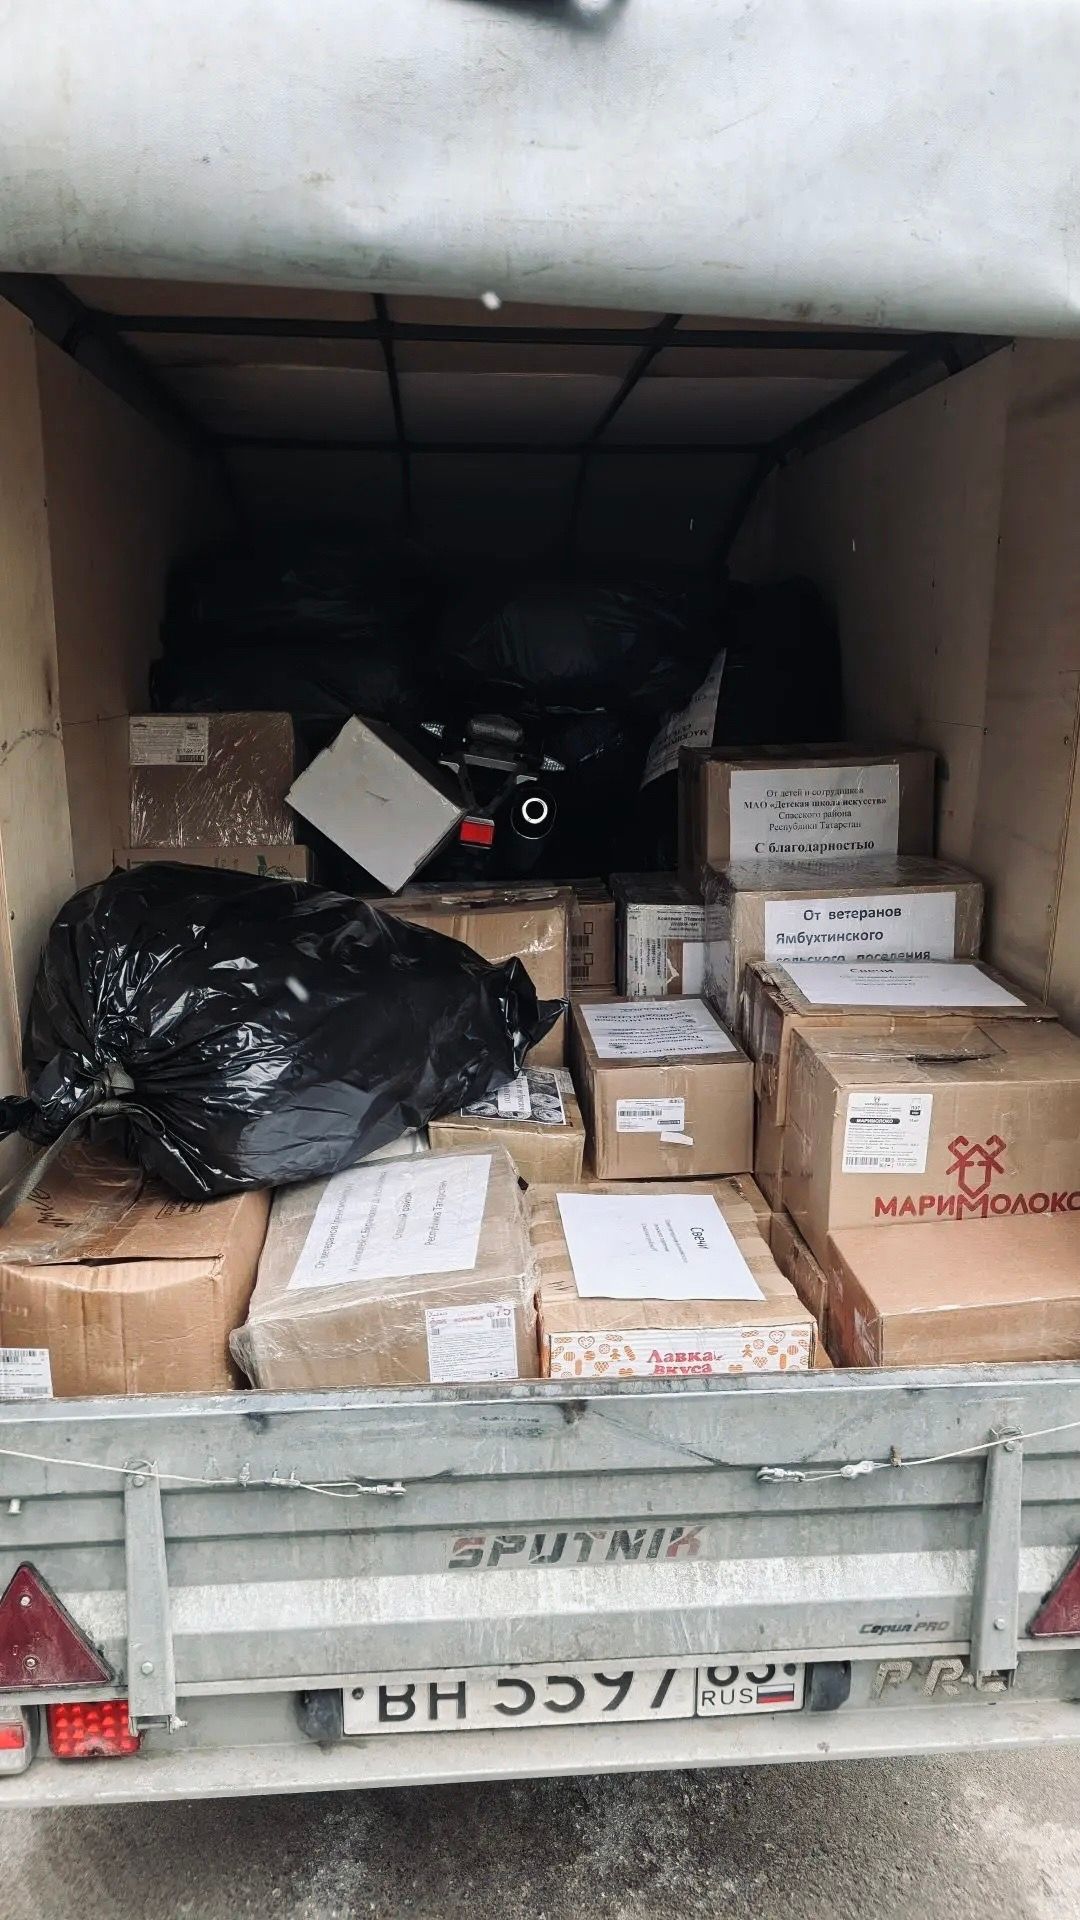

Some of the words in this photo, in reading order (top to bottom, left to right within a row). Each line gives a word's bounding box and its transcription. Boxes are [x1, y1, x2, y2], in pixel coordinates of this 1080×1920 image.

[780, 789, 803, 798] детей
[778, 812, 821, 820] Спасского
[823, 810, 852, 819] района
[819, 821, 862, 831] Татарстан
[754, 842, 767, 854] С
[768, 840, 875, 854] благодарностью
[803, 909, 821, 921] От
[828, 907, 902, 921] ветеранов
[776, 930, 884, 946] Ямбухтинского
[690, 1226, 709, 1250] Свечи
[646, 1349, 713, 1363] Лавка
[653, 1363, 712, 1376] вкуса
[448, 1526, 707, 1569] SPUTNIK
[859, 1622, 912, 1635] Серия
[913, 1621, 950, 1633] PRO
[701, 1688, 753, 1707] RUS
